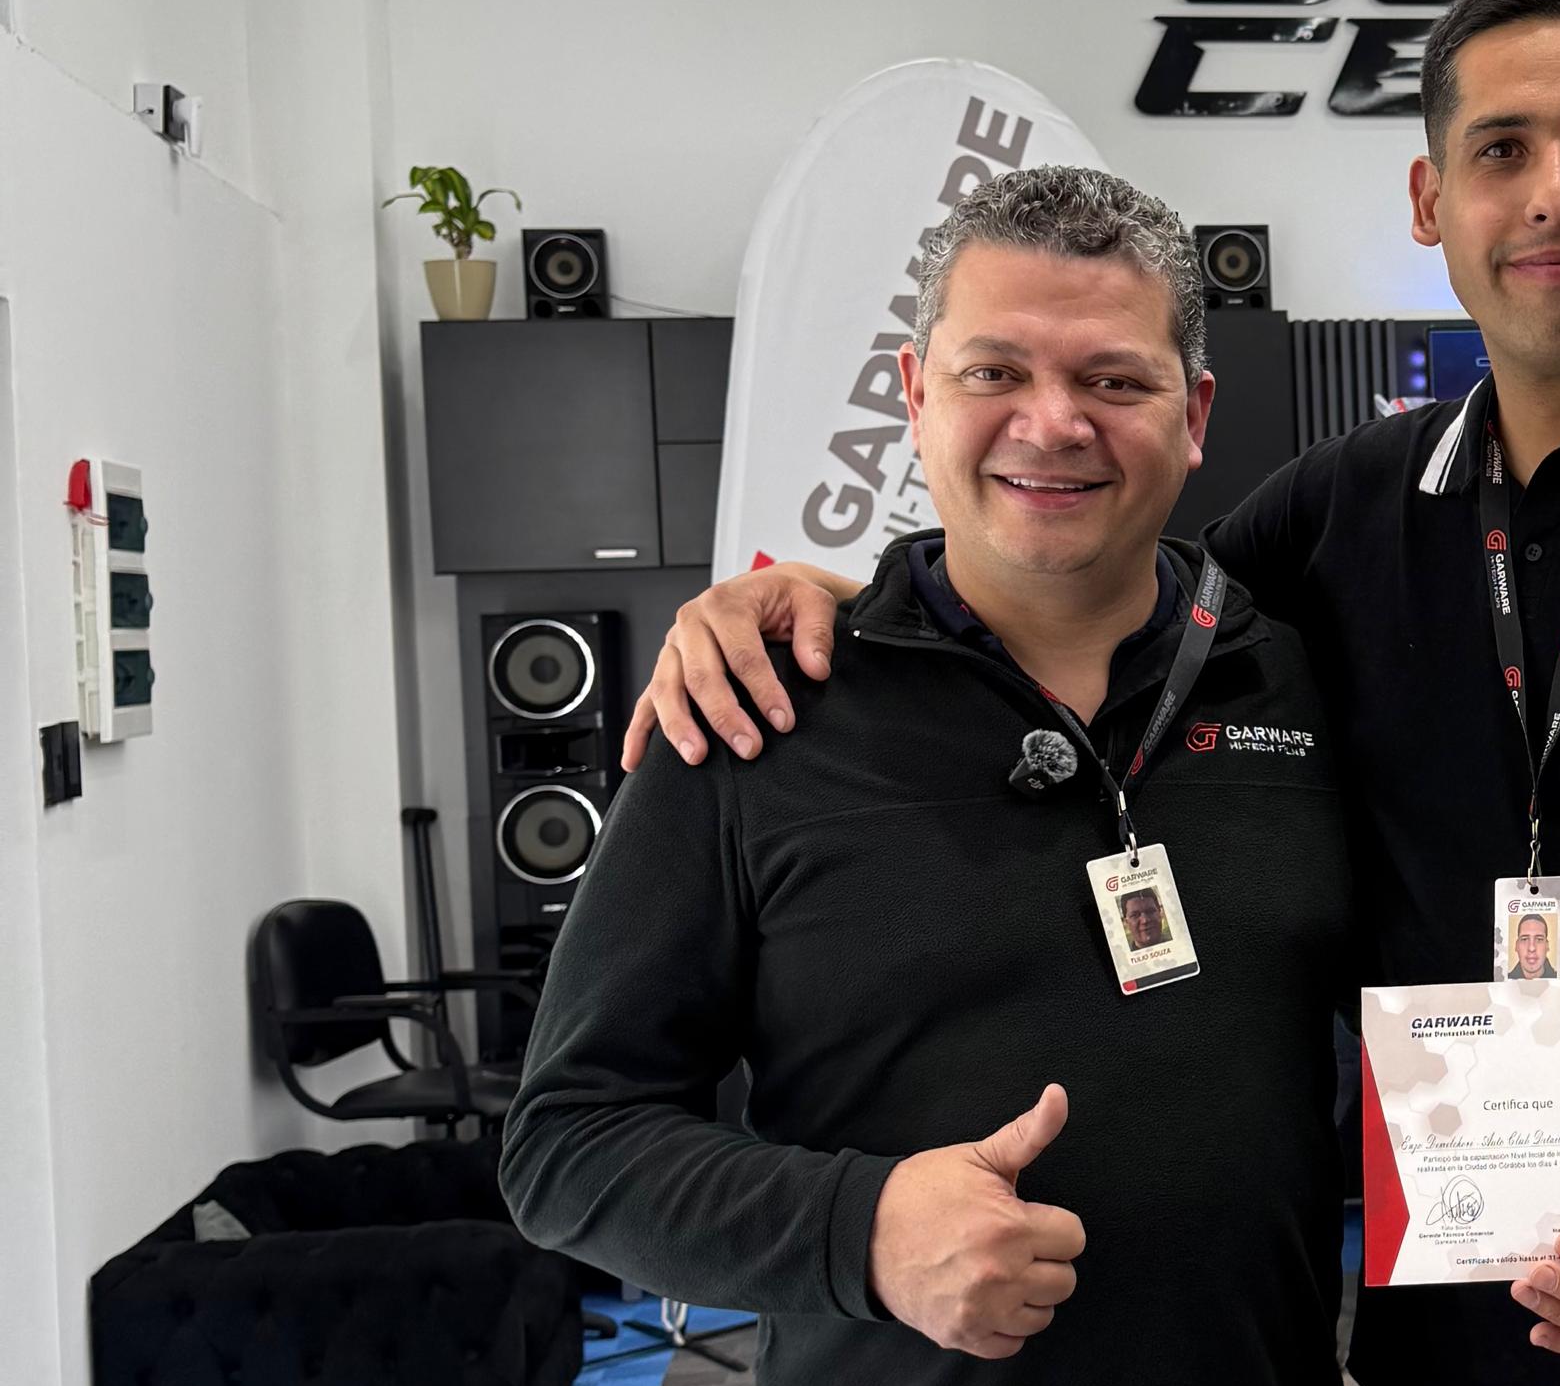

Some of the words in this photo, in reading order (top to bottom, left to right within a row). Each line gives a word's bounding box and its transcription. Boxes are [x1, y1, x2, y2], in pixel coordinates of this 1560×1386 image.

[802, 96, 1034, 548] GARRE
[1495, 553, 1511, 616] GARWARE
[1225, 724, 1315, 747] GARWARE
[1228, 740, 1275, 753] HI-TECH
[1120, 868, 1159, 884] GARWARE
[1411, 1014, 1494, 1030] GARWARE
[1483, 1099, 1529, 1112] Certifica
[1532, 1099, 1553, 1112] que
[1464, 1163, 1487, 1171] Ciudad
[1456, 1257, 1495, 1265] Certificado
